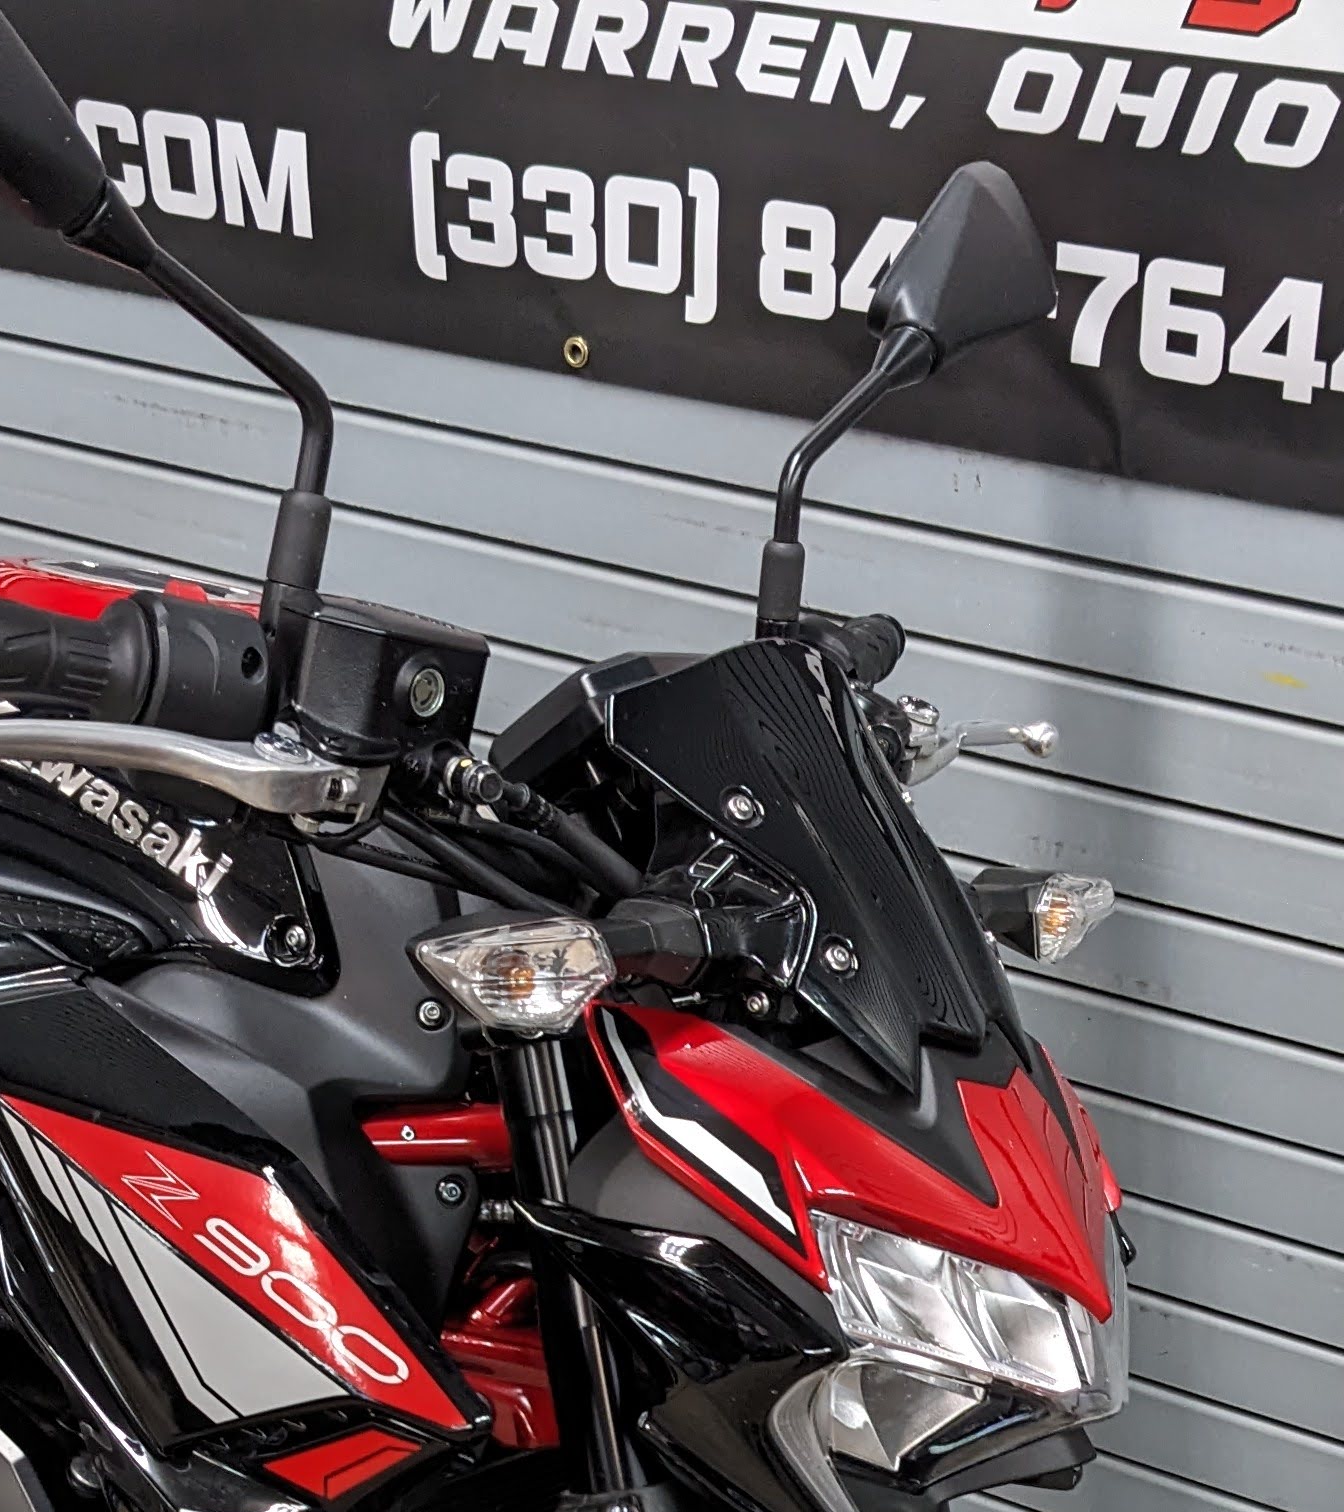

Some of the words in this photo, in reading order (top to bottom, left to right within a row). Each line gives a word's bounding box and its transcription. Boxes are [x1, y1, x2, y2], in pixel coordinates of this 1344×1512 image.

[388, 0, 926, 130] WARREN,
[985, 47, 1342, 169] OHIO
[410, 131, 720, 325] (330)
[193, 1217, 409, 1385] 900
